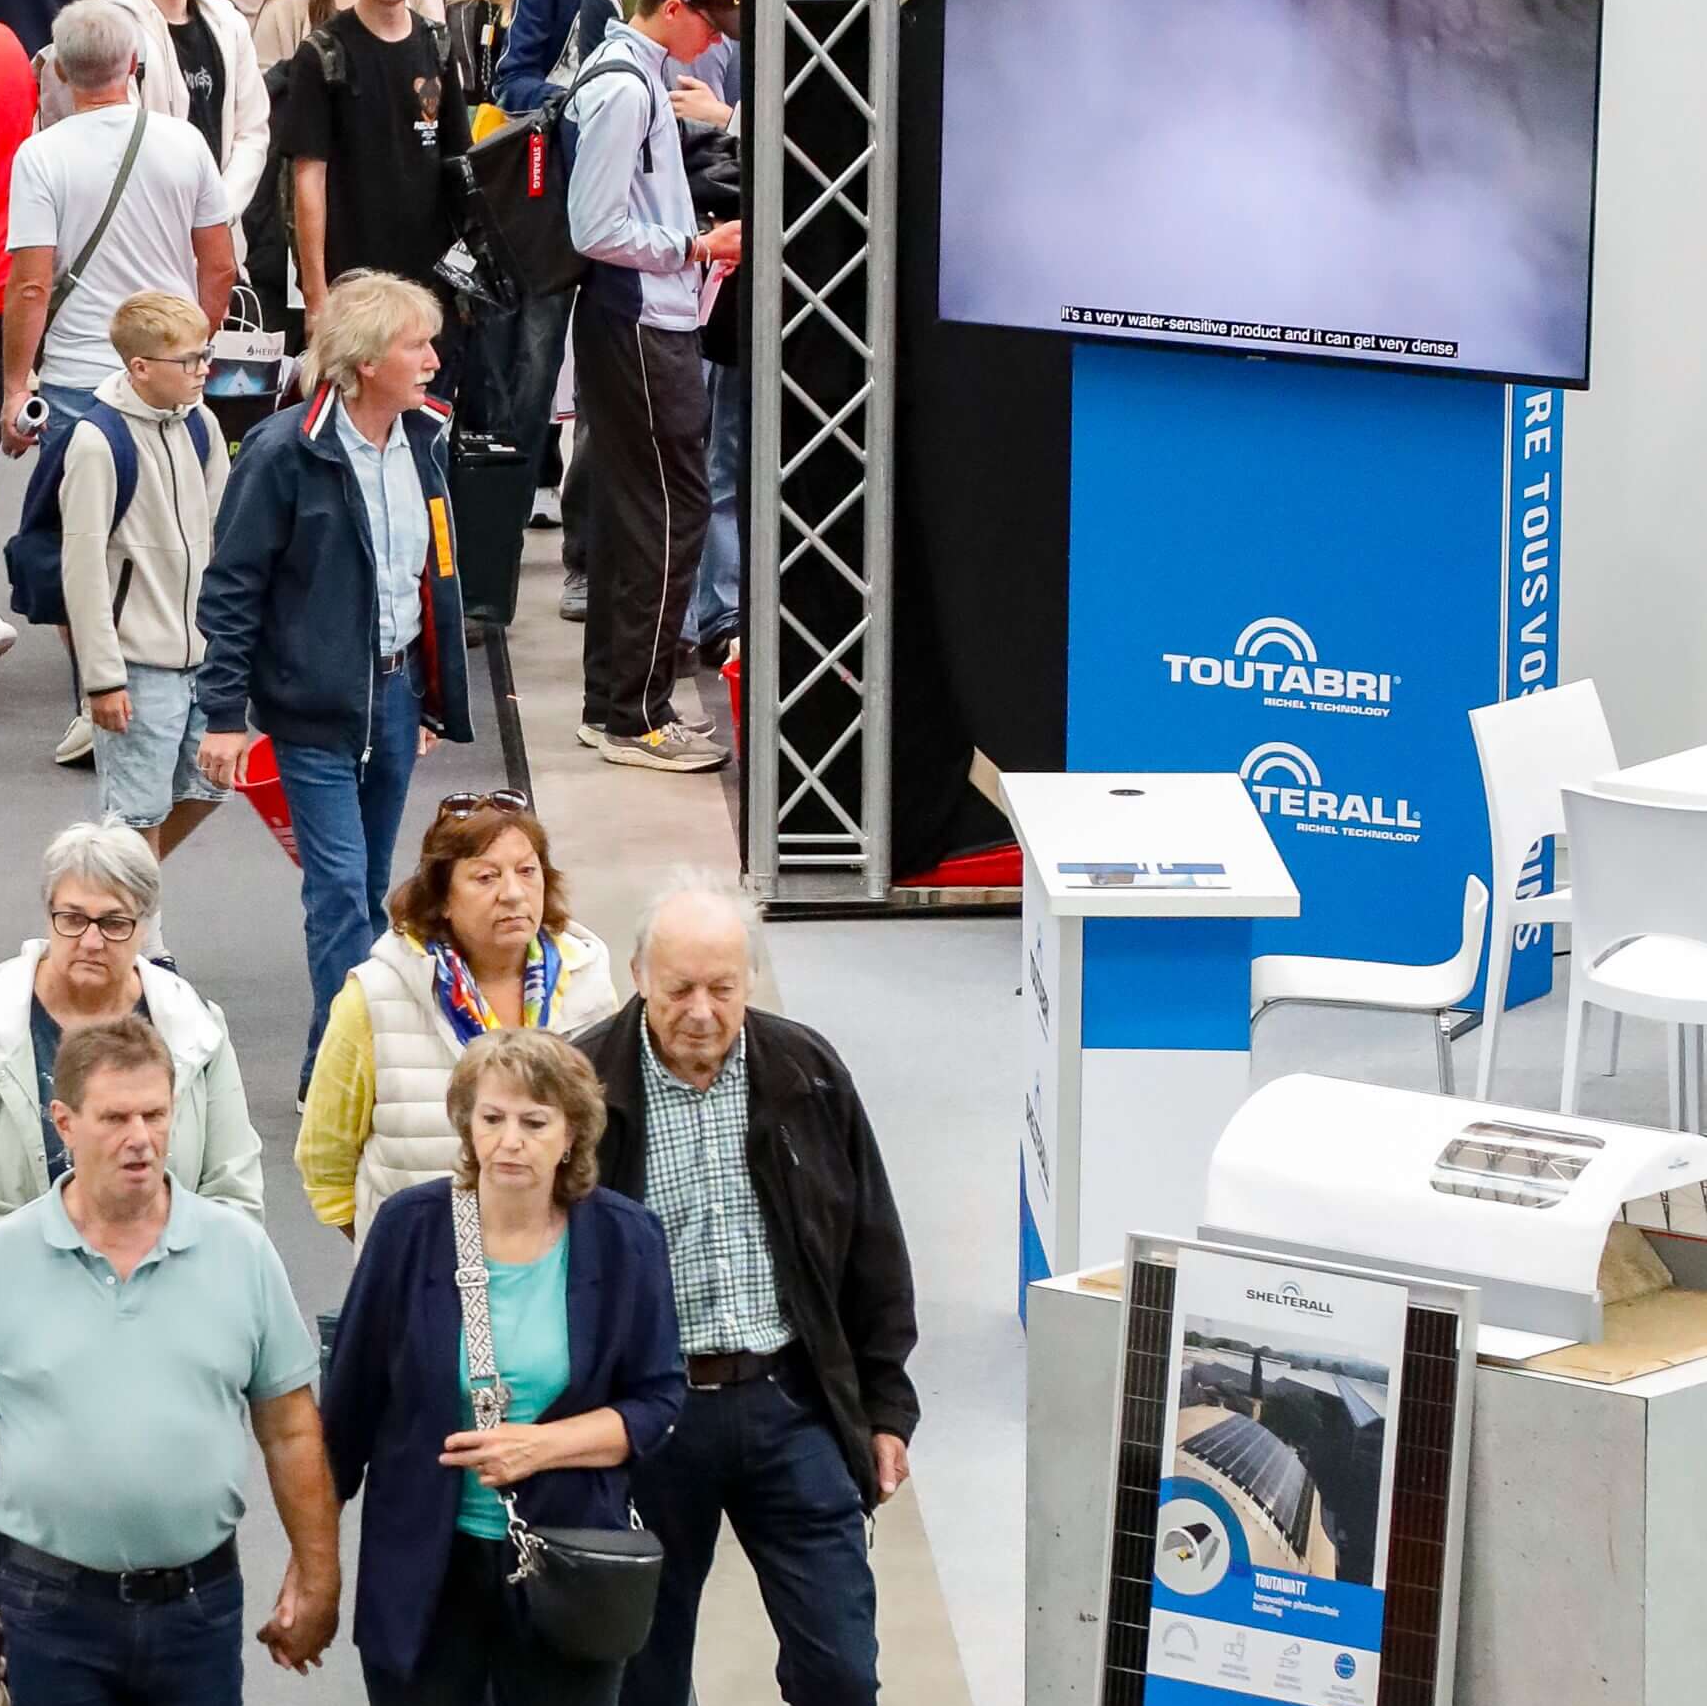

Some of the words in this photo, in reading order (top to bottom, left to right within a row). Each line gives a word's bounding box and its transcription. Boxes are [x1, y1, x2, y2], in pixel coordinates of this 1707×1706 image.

[532, 146, 542, 190] STRABAG
[1061, 306, 1080, 321] It's
[1083, 311, 1093, 322] a
[1095, 312, 1125, 327] very
[1128, 314, 1228, 335] water-sensitive
[1230, 323, 1282, 339] product
[1284, 327, 1311, 342] and
[1313, 329, 1323, 343] it
[1325, 332, 1351, 346] can
[1353, 335, 1376, 350] get
[1379, 337, 1409, 354] very
[1411, 339, 1459, 358] dense,
[1524, 389, 1552, 461] RE
[1521, 471, 1551, 608] TOUS
[1162, 653, 1392, 703] TOUTABRI
[1263, 696, 1307, 710] RICHEL
[1309, 700, 1391, 718] TECHNOLOGY
[1251, 784, 1422, 829] TERALL
[1296, 822, 1339, 836] RICHEL
[1342, 826, 1421, 844] TECHNOLOGY
[1245, 1288, 1335, 1314] SHELTERALL
